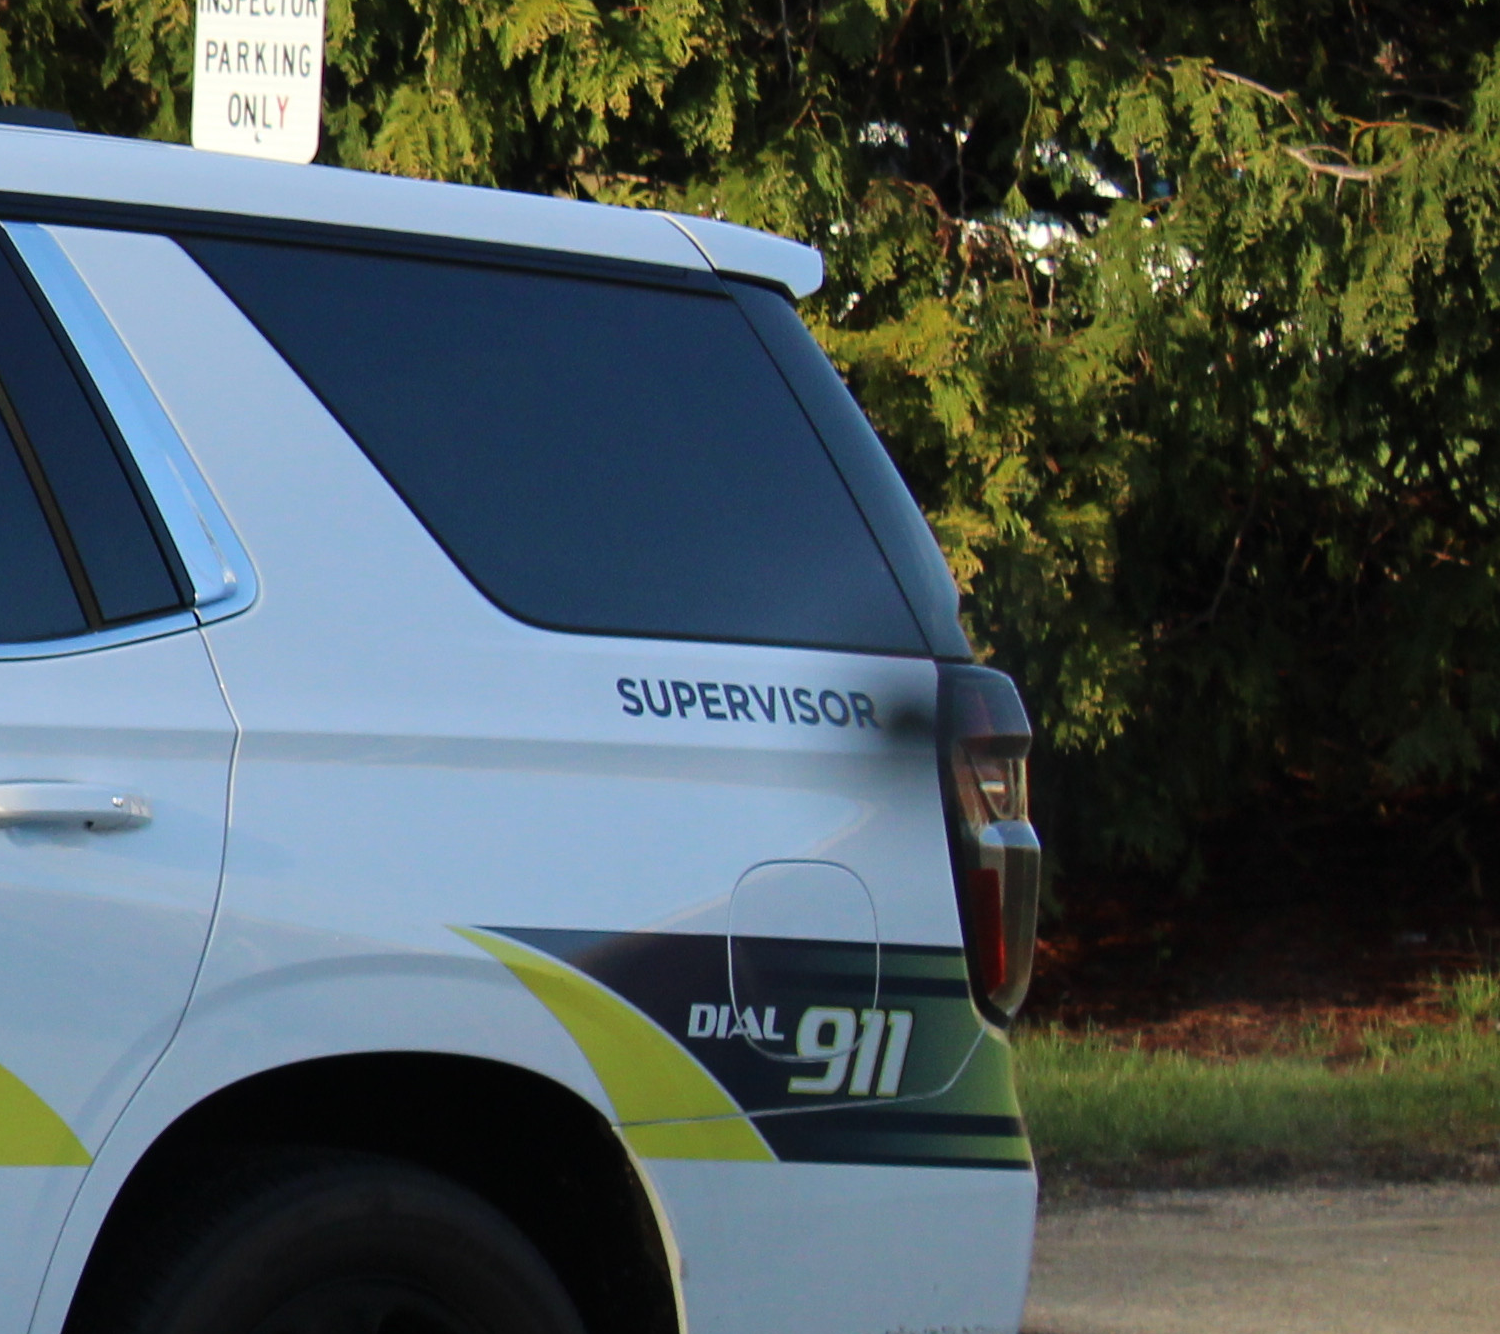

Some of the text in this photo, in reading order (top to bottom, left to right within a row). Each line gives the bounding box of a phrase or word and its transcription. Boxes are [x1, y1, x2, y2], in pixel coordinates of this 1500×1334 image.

[205, 40, 312, 78] PARKING
[228, 92, 289, 130] ONLY
[616, 677, 882, 729] SUPERVISOR
[687, 1002, 913, 1097] DIAL 911
